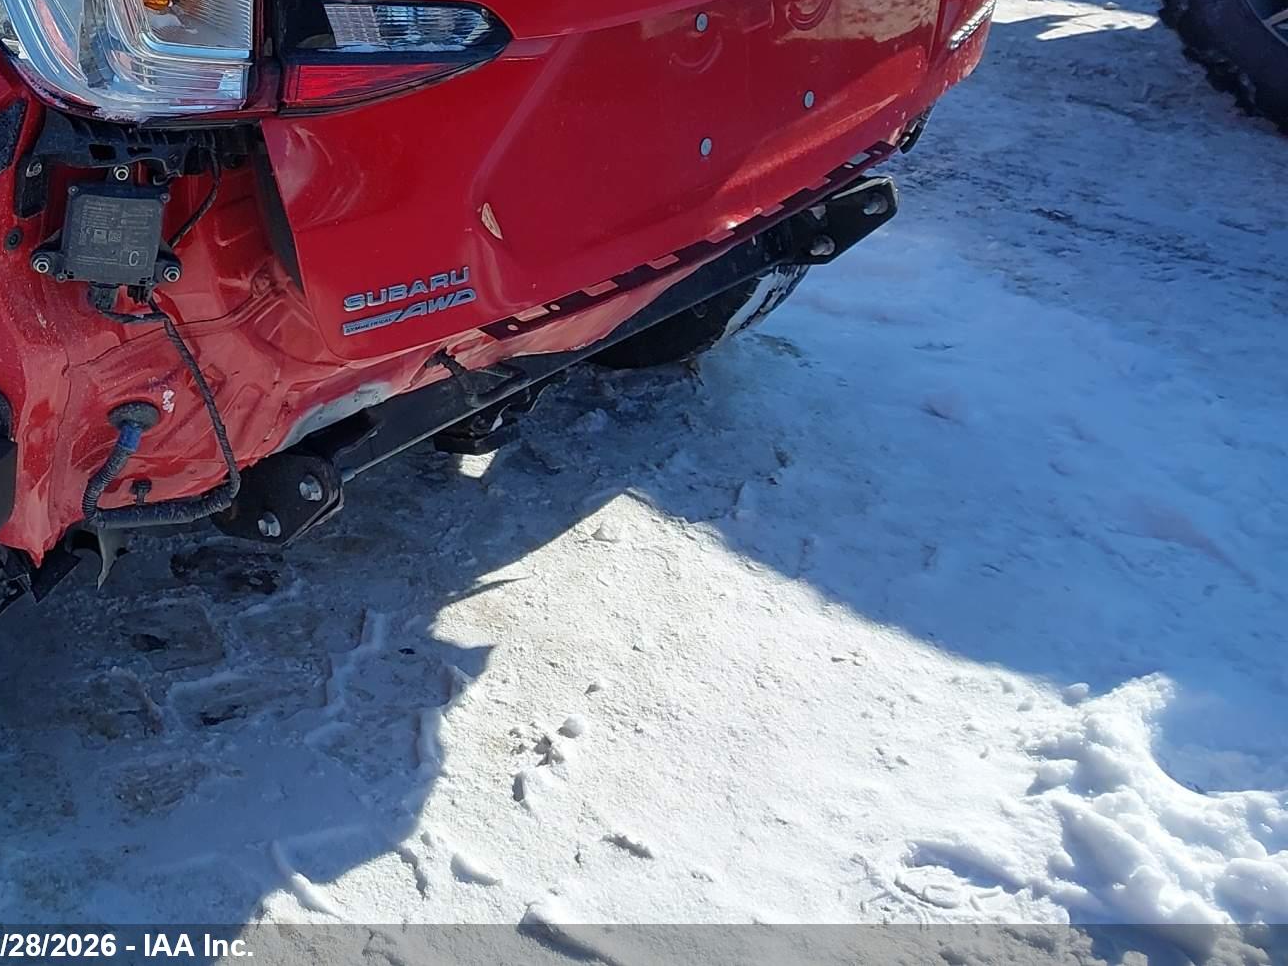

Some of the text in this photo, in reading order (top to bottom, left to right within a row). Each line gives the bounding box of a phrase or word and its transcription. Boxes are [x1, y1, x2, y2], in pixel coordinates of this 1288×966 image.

[128, 250, 140, 267] C
[343, 266, 470, 312] SUBARU
[394, 288, 477, 323] AWD
